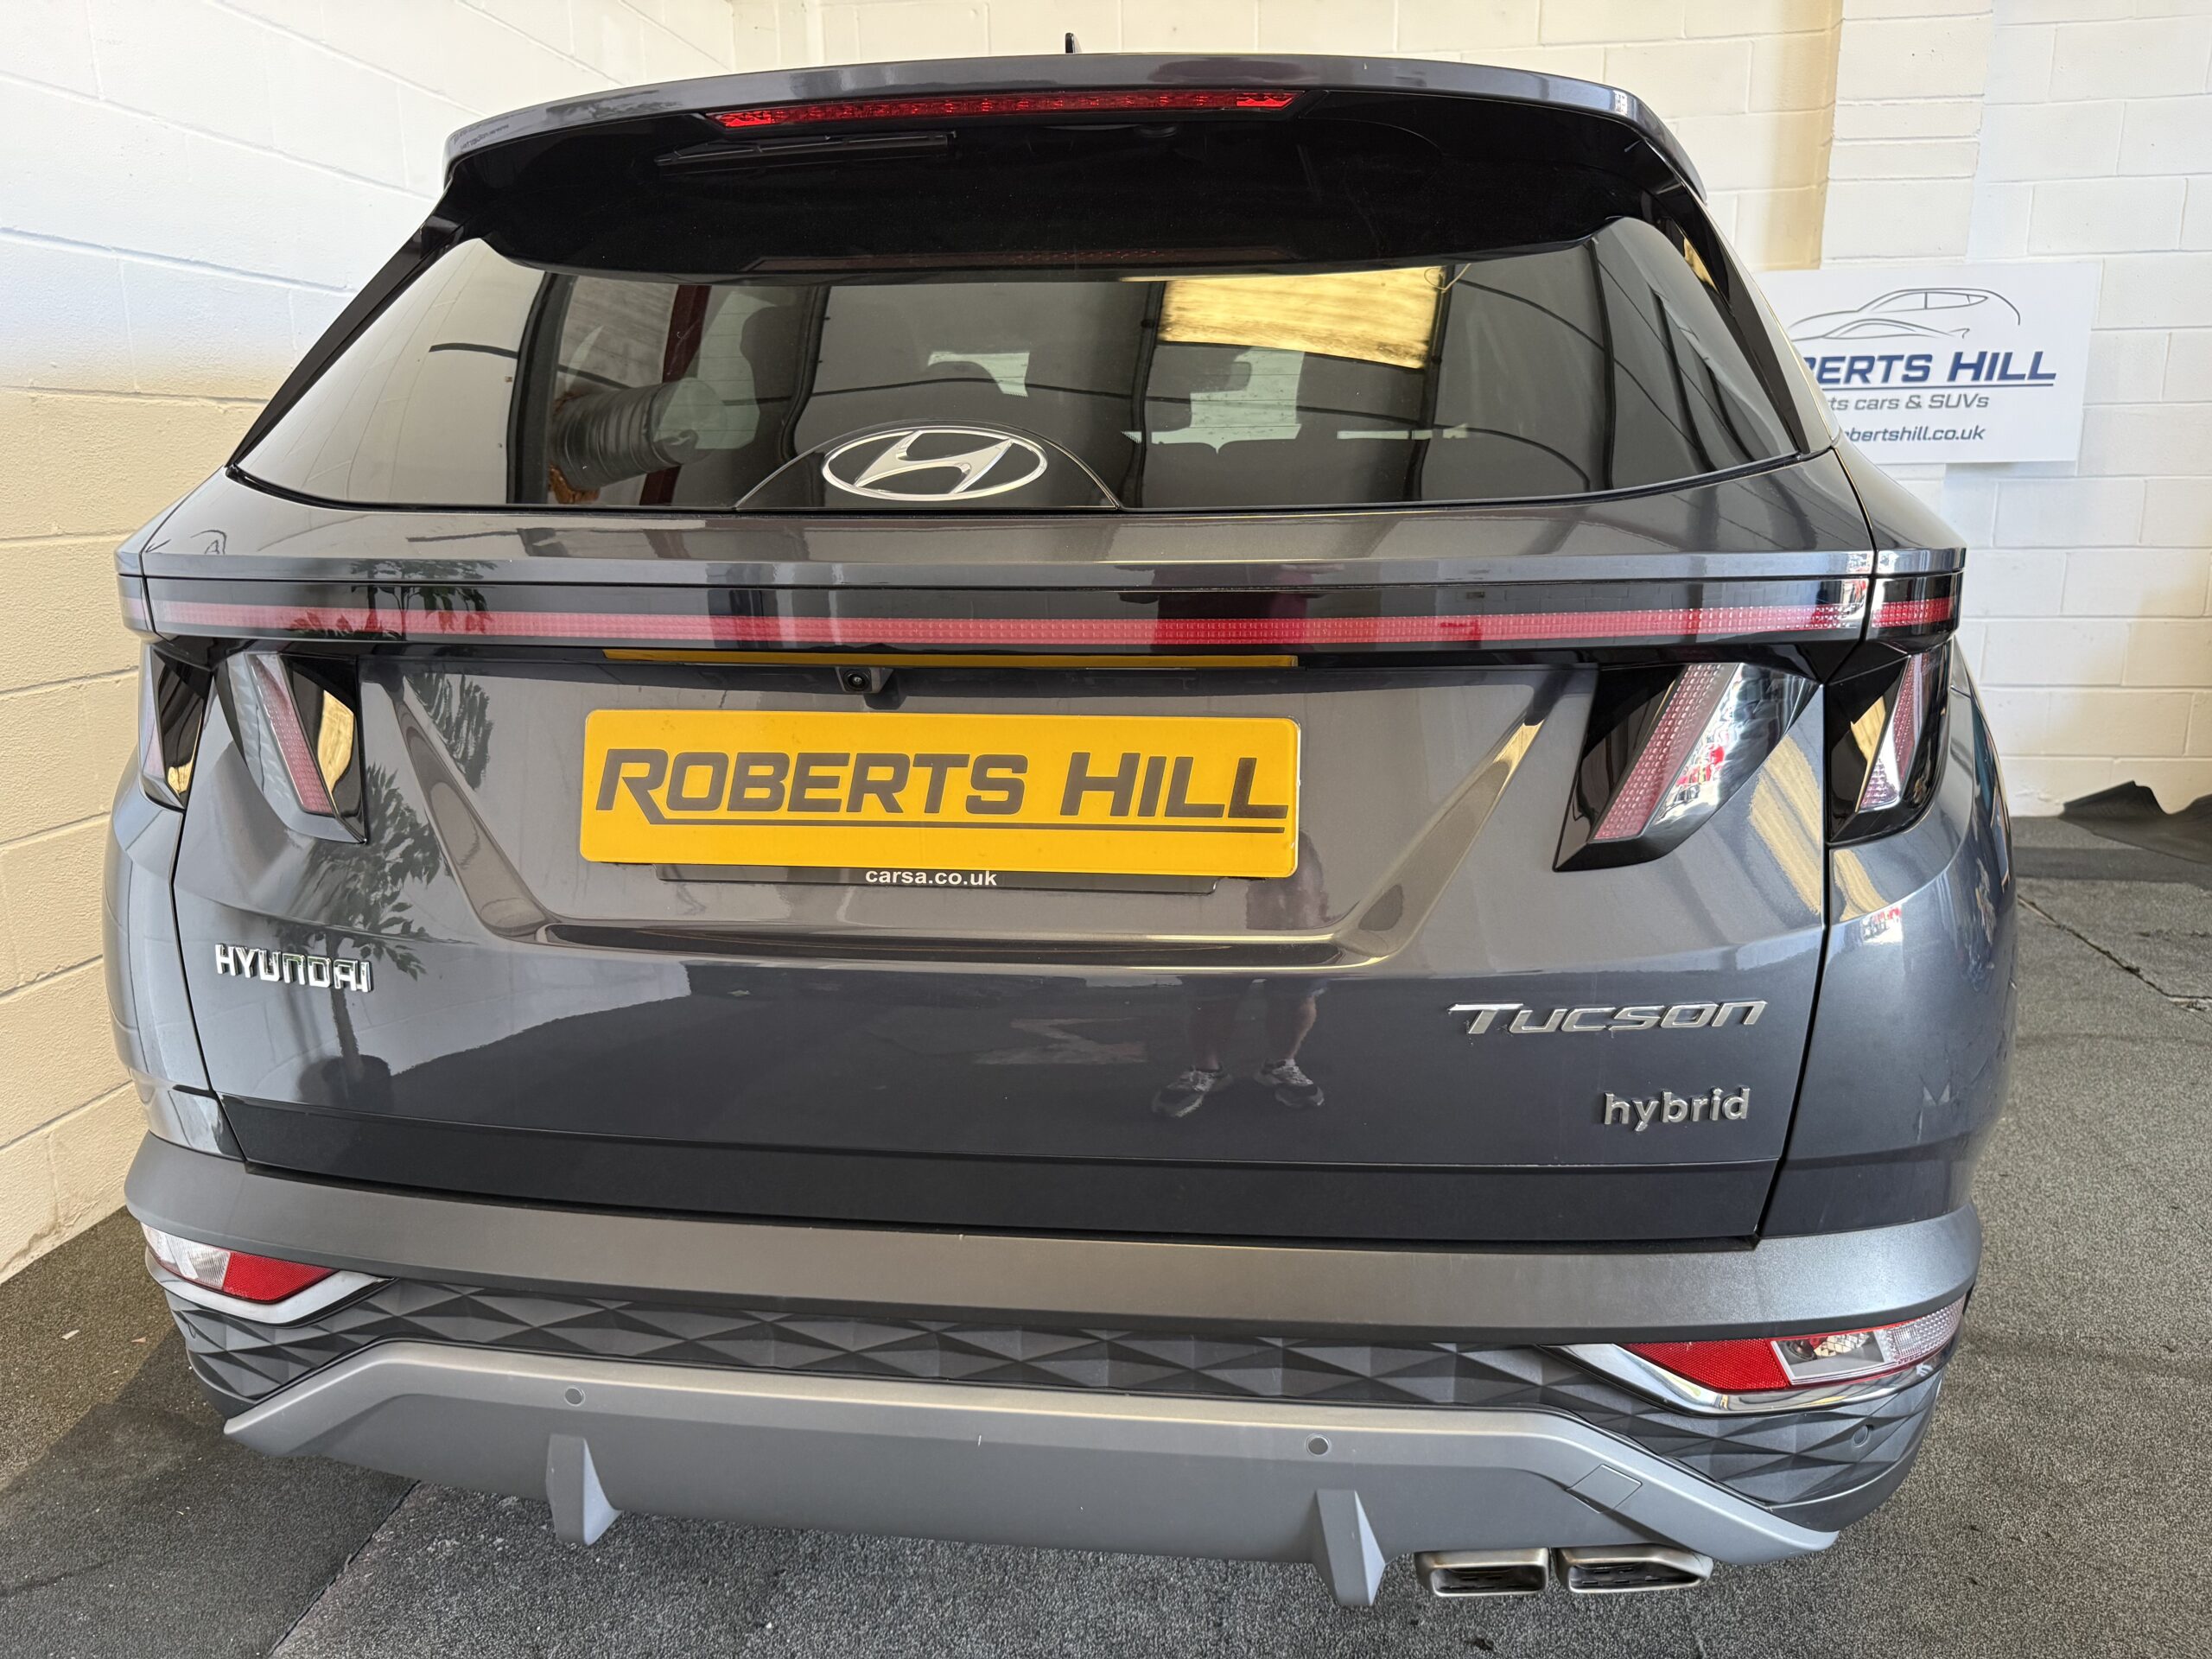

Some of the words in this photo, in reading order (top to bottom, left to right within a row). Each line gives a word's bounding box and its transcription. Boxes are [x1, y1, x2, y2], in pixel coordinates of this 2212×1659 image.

[1947, 351, 2056, 382] HILL
[1827, 397, 1849, 410] ts
[1854, 397, 1899, 410] cars
[1905, 395, 1922, 409] &
[1928, 393, 1989, 409] SUVs
[596, 748, 1028, 825] ROBERTS
[1060, 752, 1288, 818] HILL
[865, 870, 997, 886] carsa.co.uk
[215, 944, 372, 993] HYUNDAI
[1604, 1087, 1750, 1132] hybrid
